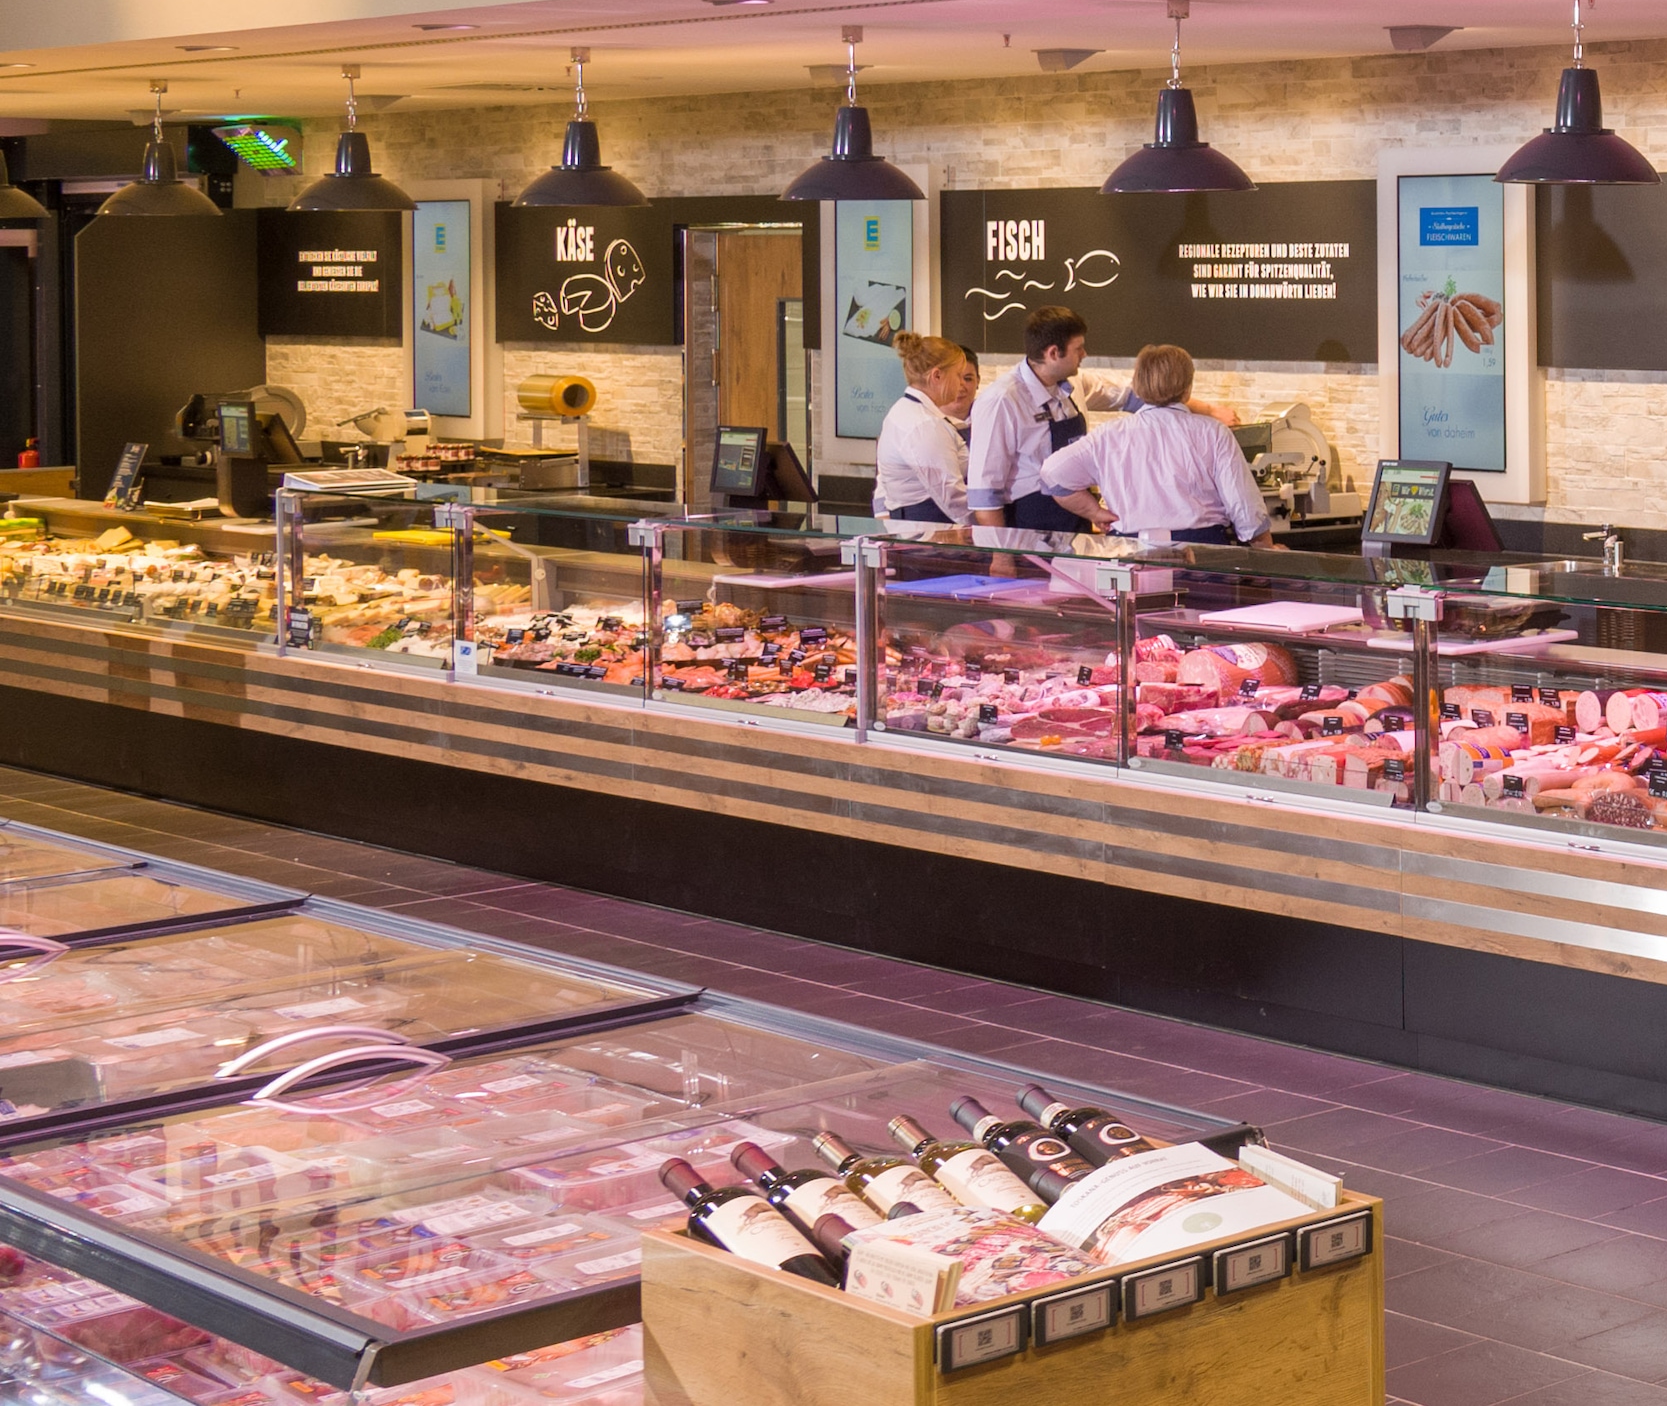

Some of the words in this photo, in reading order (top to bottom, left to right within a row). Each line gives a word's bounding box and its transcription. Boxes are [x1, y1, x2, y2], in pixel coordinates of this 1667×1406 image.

[557, 218, 594, 261] KÄSE
[986, 219, 1046, 261] FISCH
[1179, 244, 1220, 258] REGIONALE
[1221, 243, 1270, 258] REZEPTUREN
[1271, 243, 1288, 258] UND
[1289, 243, 1314, 257] BESTE
[1315, 243, 1349, 258] ZUTATEN
[1193, 264, 1212, 278] SIND
[1213, 264, 1243, 278] GARANT
[1244, 261, 1260, 278] FÜR
[1261, 261, 1334, 280] SPITZENQUALITÄT,
[1191, 284, 1207, 298] WIE
[1208, 284, 1224, 298] WIR
[1225, 284, 1238, 298] SIE
[1239, 284, 1249, 298] IN
[1250, 281, 1303, 298] DONAUWÖRTH
[1304, 282, 1337, 299] LIEBEN!
